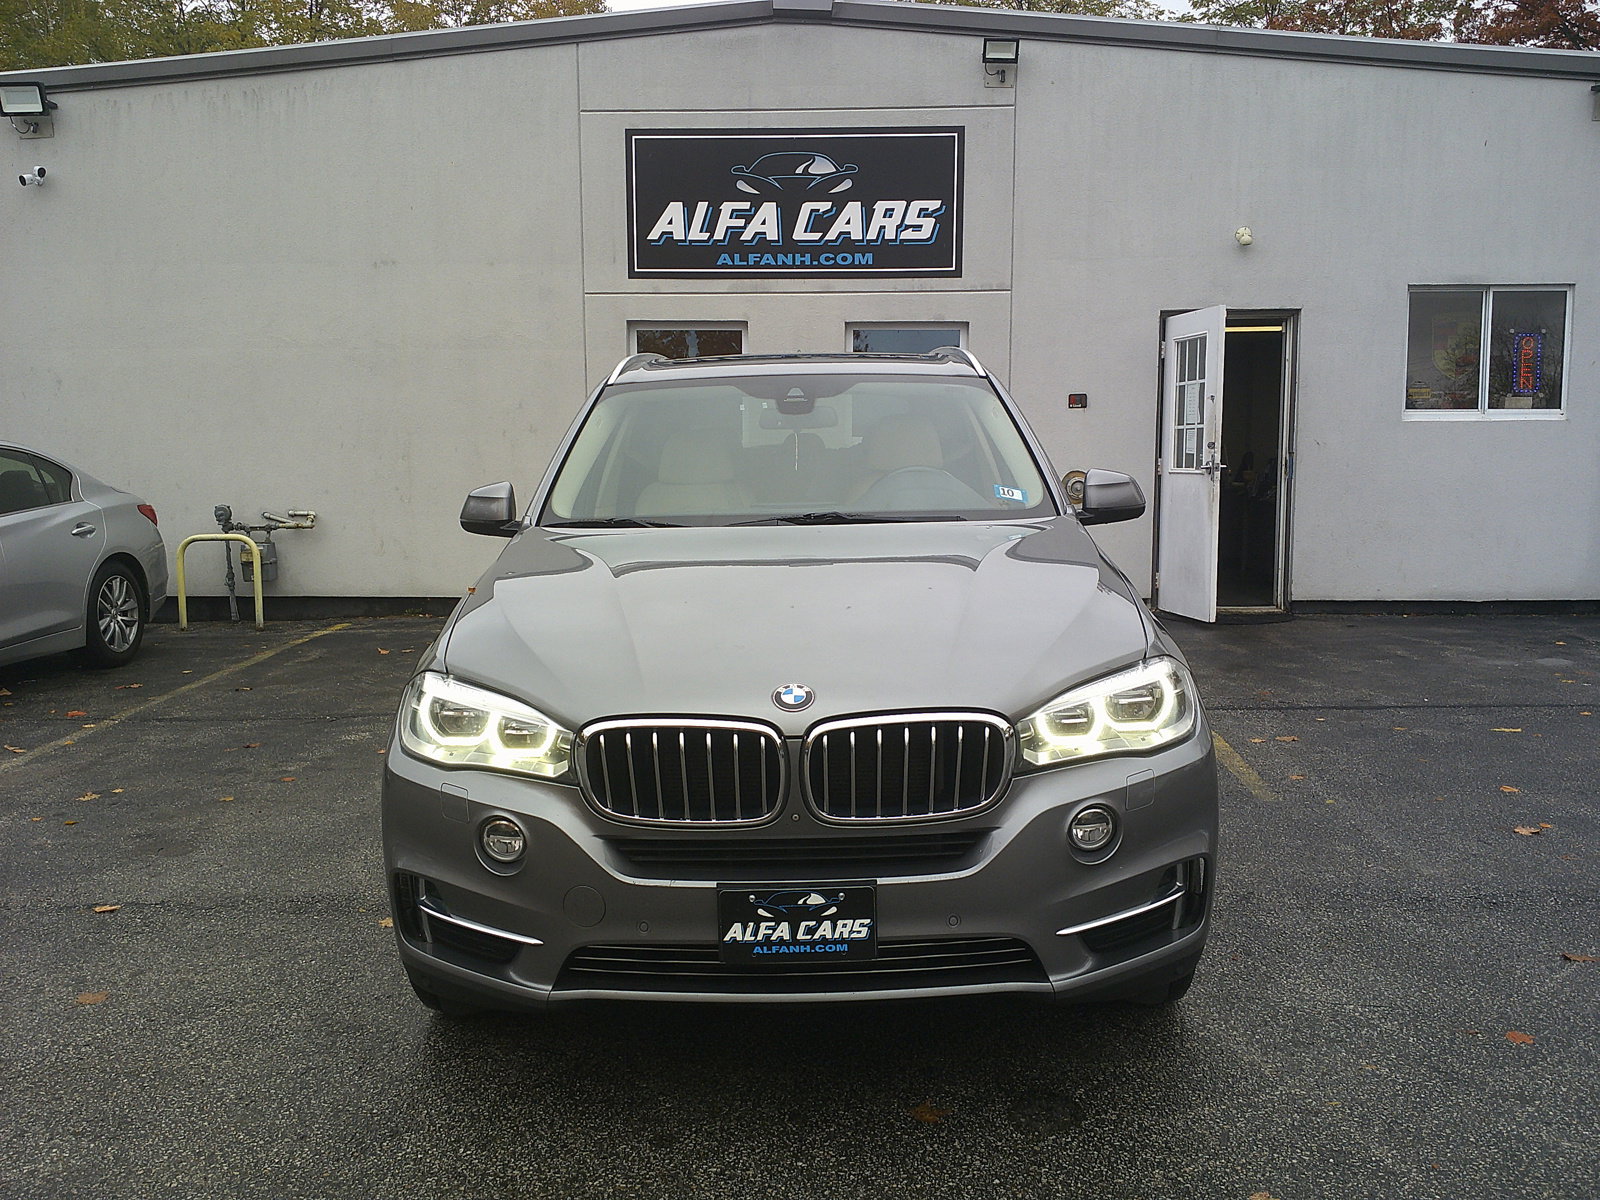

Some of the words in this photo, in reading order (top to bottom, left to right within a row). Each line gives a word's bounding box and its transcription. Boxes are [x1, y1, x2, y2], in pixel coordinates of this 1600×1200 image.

[647, 202, 782, 245] ALFA
[792, 200, 946, 245] CARS
[716, 253, 873, 266] ALFANH.COM
[1520, 337, 1534, 389] OPEN
[1001, 488, 1014, 497] 10
[723, 921, 791, 943] ALFA
[797, 919, 873, 942] CARS
[753, 943, 848, 954] ALFANH.COM
